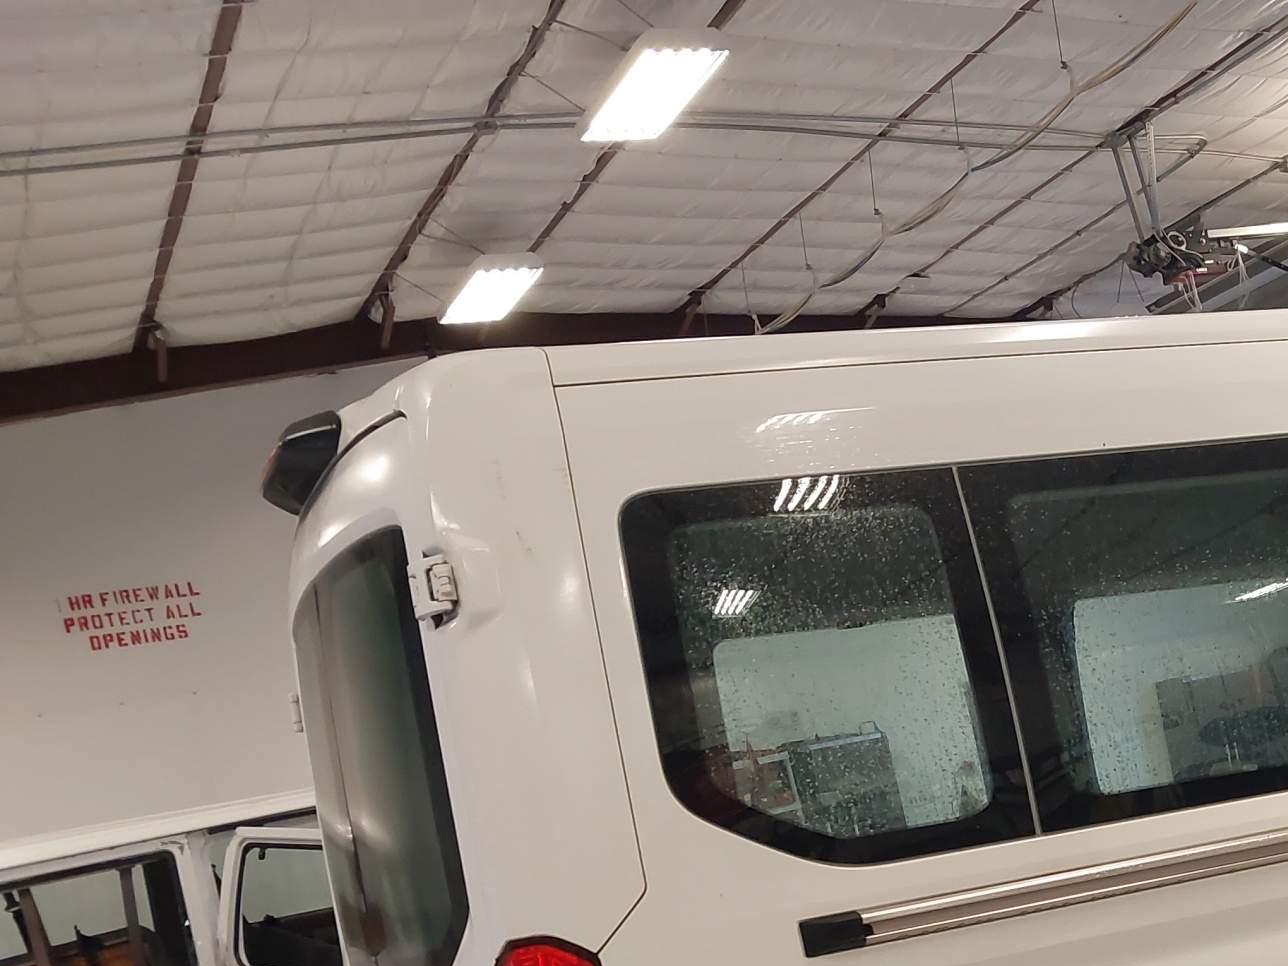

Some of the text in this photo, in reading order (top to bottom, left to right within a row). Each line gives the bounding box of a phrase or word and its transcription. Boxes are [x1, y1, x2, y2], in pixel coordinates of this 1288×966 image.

[67, 593, 95, 611] HR
[99, 582, 200, 607] FIREWALL
[63, 602, 202, 633] PROTECT ALL
[89, 624, 189, 651] OPENINGS
